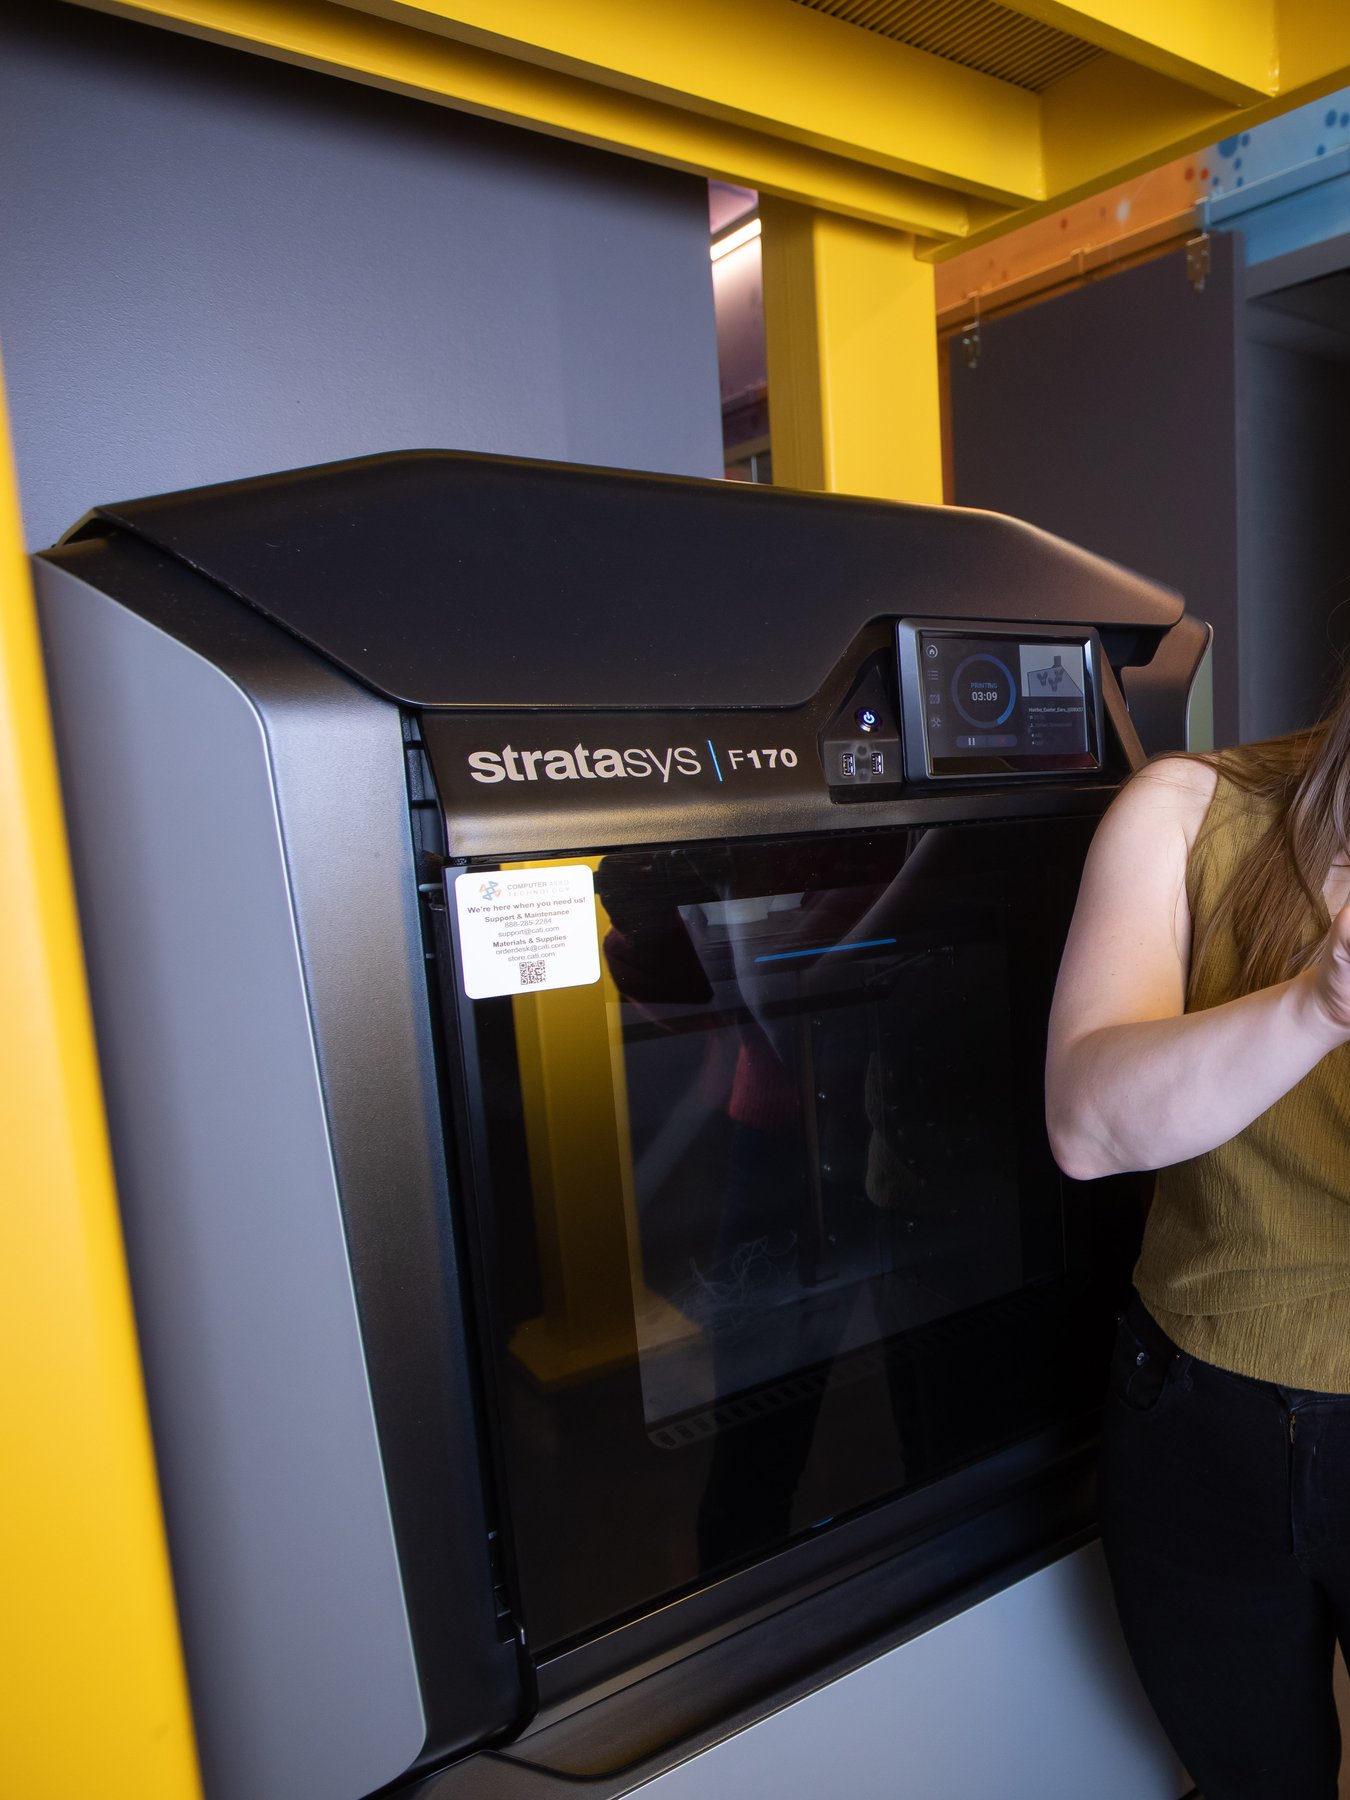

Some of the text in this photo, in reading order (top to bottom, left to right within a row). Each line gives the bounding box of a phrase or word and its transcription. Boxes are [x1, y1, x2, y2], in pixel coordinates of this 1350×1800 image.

[971, 691, 998, 702] 03:09
[468, 743, 798, 783] stratasys F170
[507, 881, 547, 890] COMPUTER
[508, 887, 570, 897] TECHNOLOGY
[467, 905, 491, 914] We're
[493, 903, 511, 912] here
[513, 901, 535, 910] when
[536, 901, 551, 909] you
[553, 898, 572, 906] need
[485, 914, 515, 924] Support
[524, 909, 570, 919] Maintenance
[504, 918, 552, 928] 888-285-2284
[498, 925, 560, 938] support@cati.com
[493, 938, 526, 948] Materials
[535, 935, 567, 944] Supplies
[496, 942, 566, 955] orderdesk@cati.com
[507, 951, 556, 962] store.cati.com
